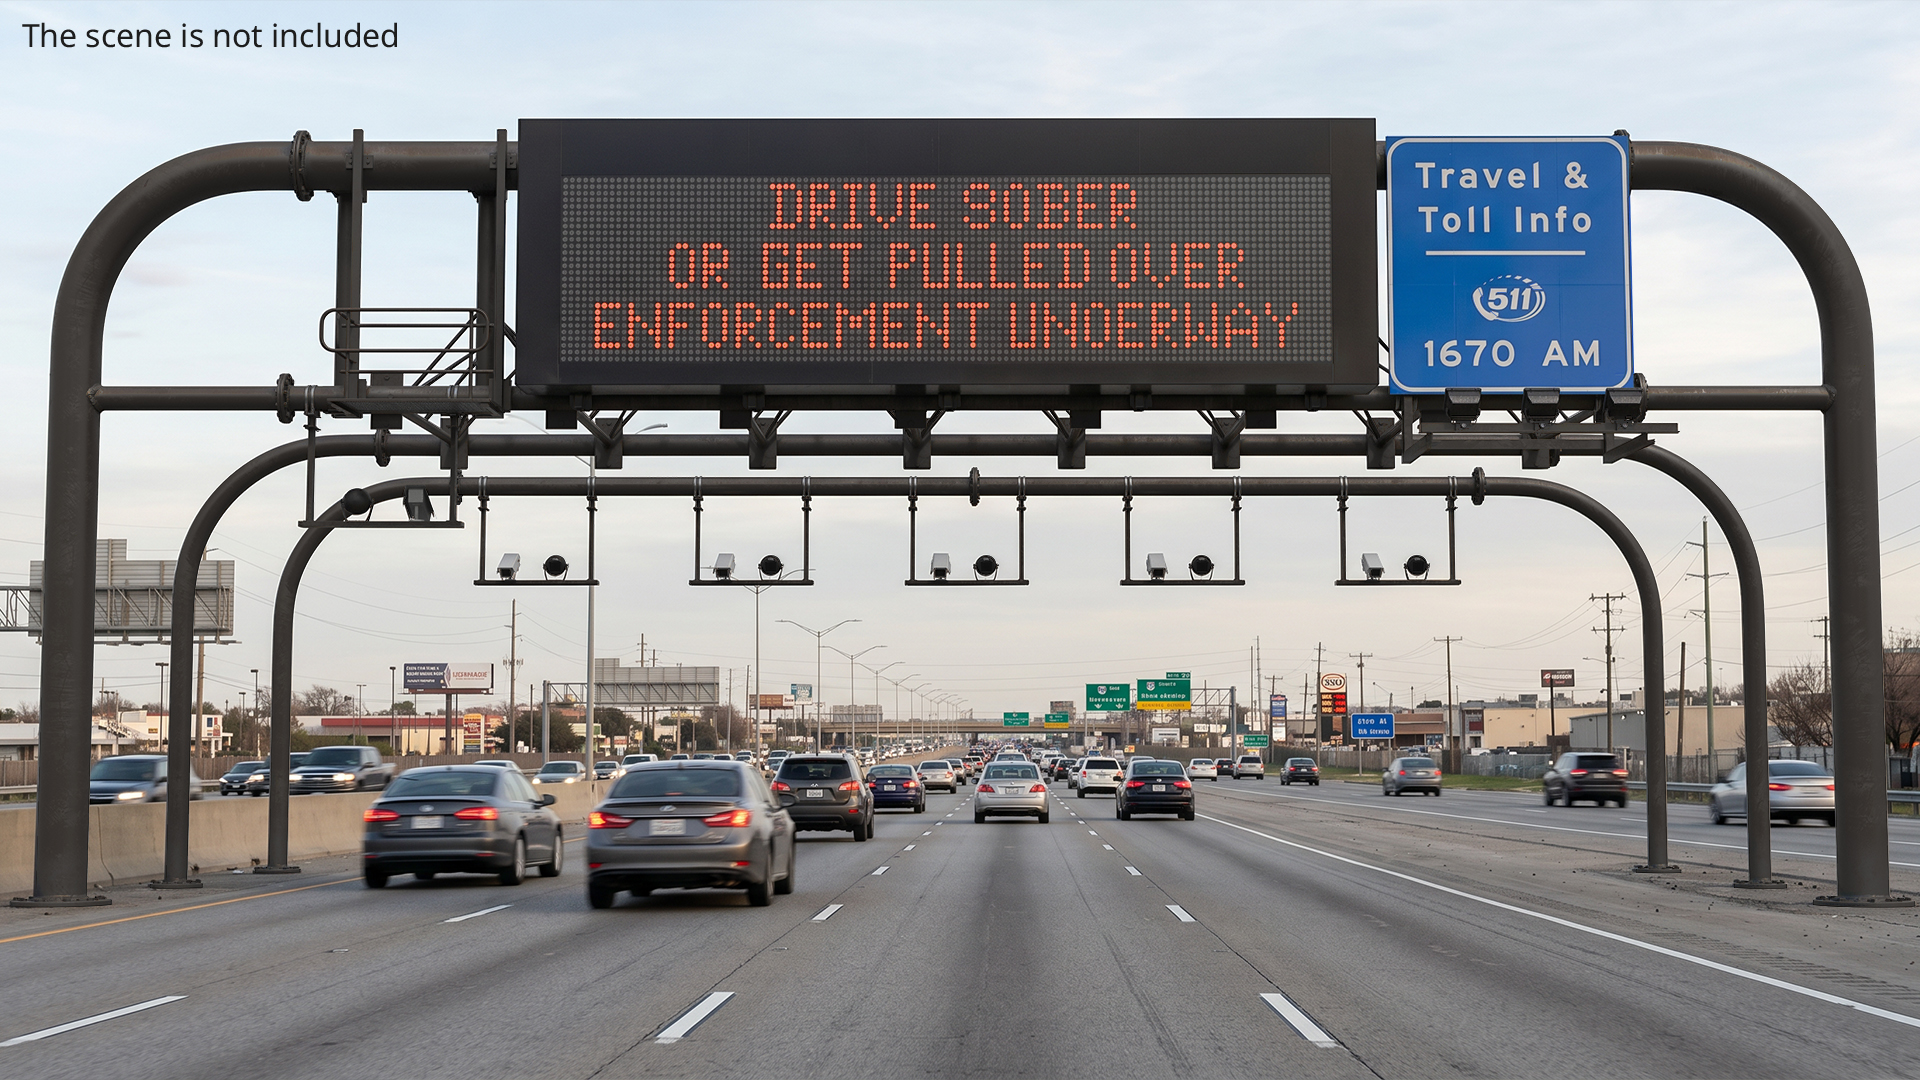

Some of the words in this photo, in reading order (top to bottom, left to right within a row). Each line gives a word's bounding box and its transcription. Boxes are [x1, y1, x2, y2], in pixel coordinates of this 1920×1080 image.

[1415, 161, 1540, 189] Travel
[1564, 161, 1589, 189] &
[769, 182, 937, 230] DRIVE
[962, 182, 1137, 230] SOBER
[1418, 205, 1490, 233] Toll
[1515, 205, 1592, 233] Info
[668, 241, 730, 290] OR
[761, 241, 863, 290] GET
[889, 241, 1091, 290] PULLED
[1110, 241, 1245, 290] OVER
[1487, 287, 1532, 311] 511
[593, 301, 991, 350] ENFORCEMENT
[1424, 339, 1515, 367] 1670
[1542, 339, 1600, 367] AM
